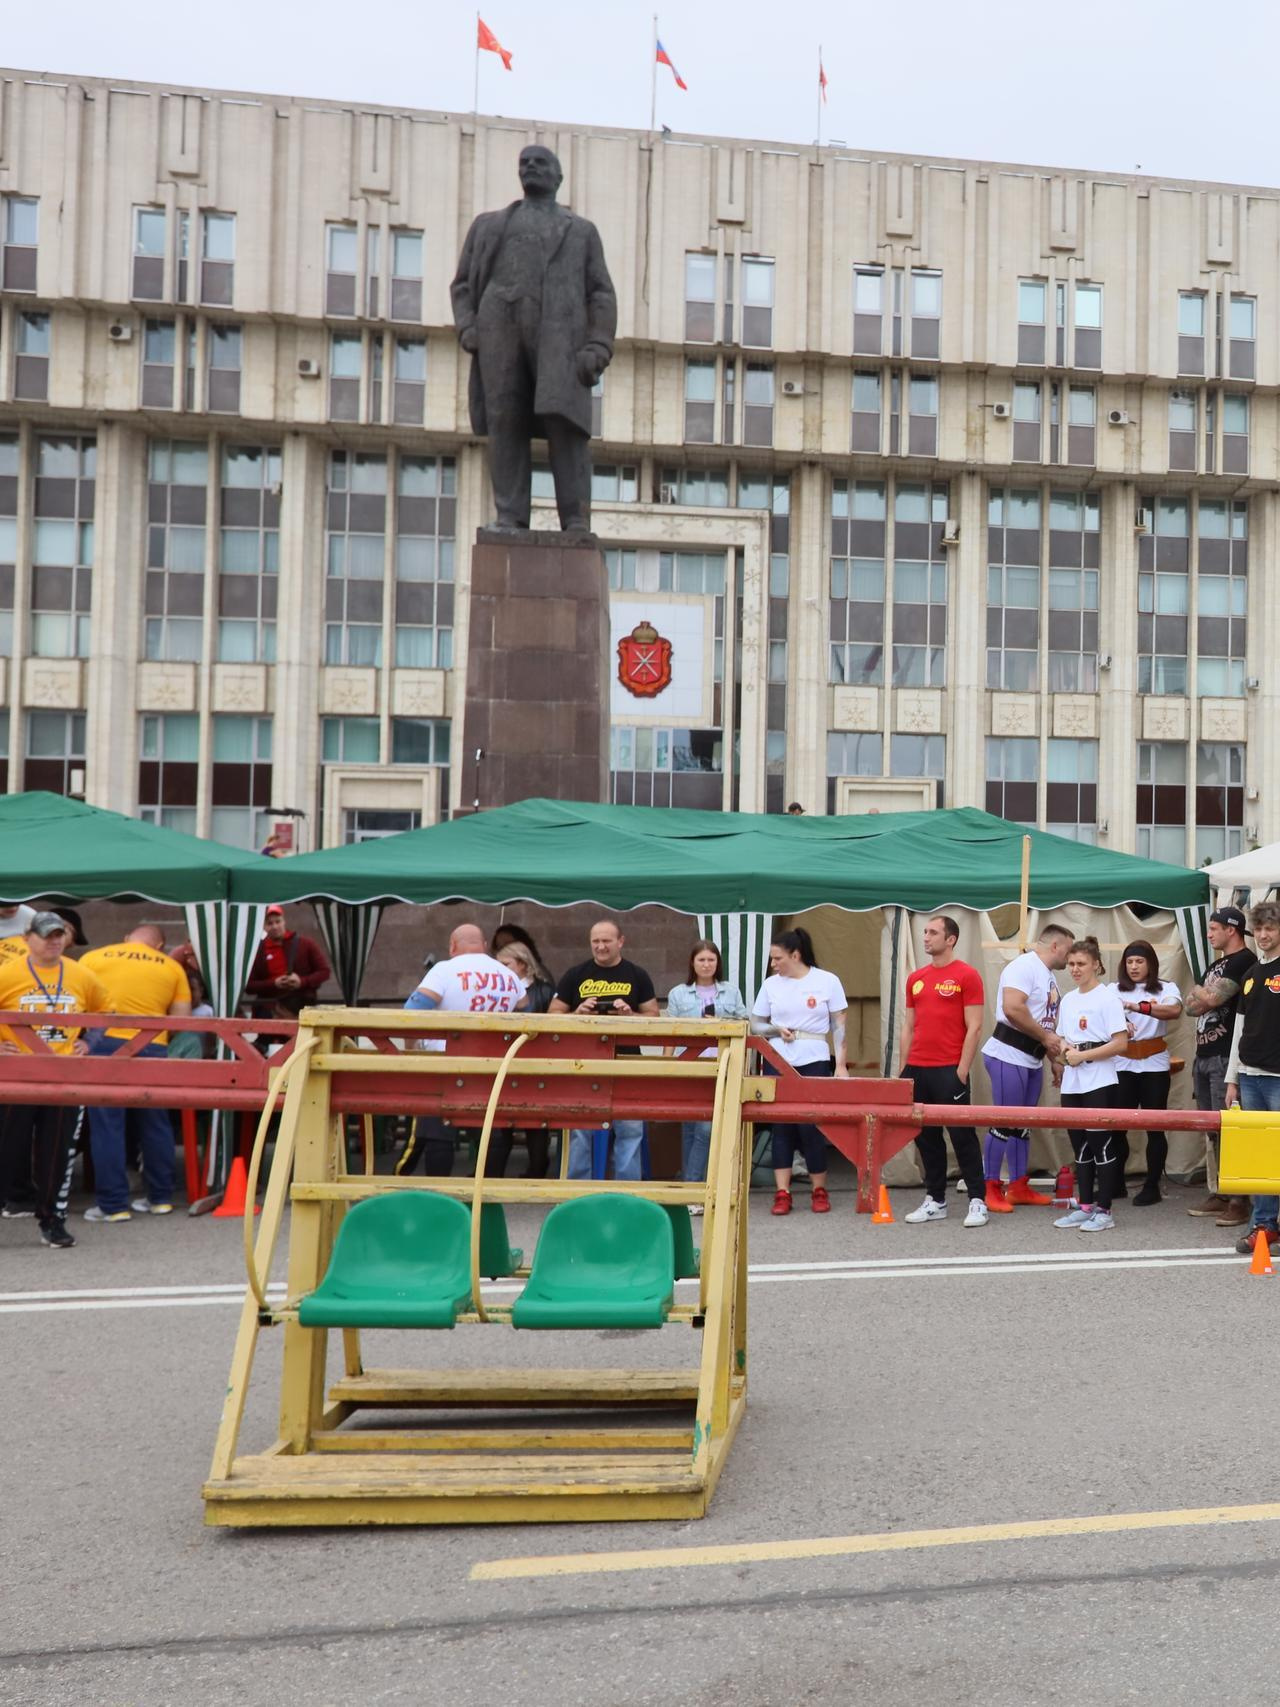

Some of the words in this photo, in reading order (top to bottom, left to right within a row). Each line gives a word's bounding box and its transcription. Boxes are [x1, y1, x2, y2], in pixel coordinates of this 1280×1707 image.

[103, 951, 165, 965] СУДЬЯ
[457, 970, 519, 994] ТУЛА
[469, 994, 511, 1012] 875
